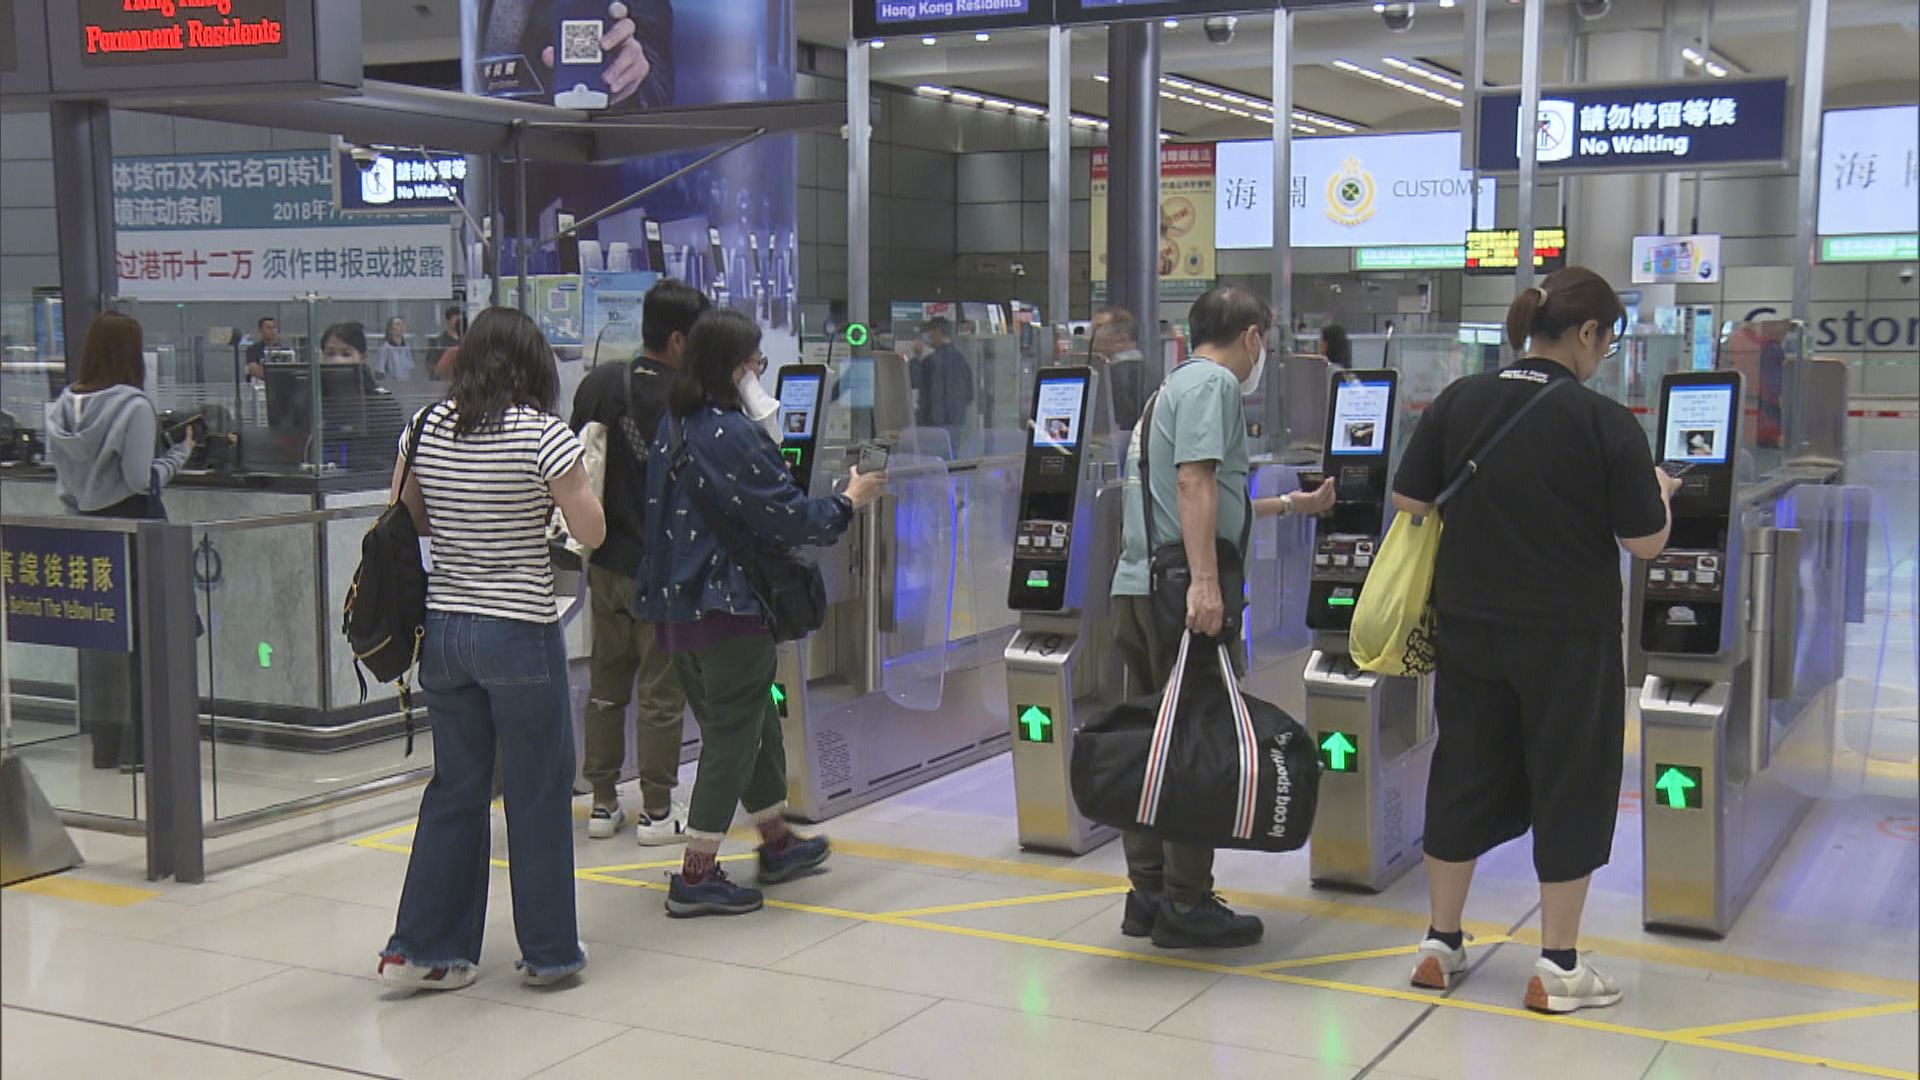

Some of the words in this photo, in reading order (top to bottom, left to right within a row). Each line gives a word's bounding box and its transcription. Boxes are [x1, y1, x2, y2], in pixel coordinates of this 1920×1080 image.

[881, 4, 917, 18] Hong
[918, 0, 953, 15] Kong
[85, 24, 184, 53] Permanent
[187, 18, 281, 47] Residents
[1579, 97, 1737, 132] 請勿停留等候
[1579, 137, 1609, 155] No
[1612, 133, 1689, 155] Waiting
[117, 249, 253, 281] 过港币十二万
[263, 246, 444, 280] 须作申报或披露
[94, 601, 115, 623] Line
[1661, 680, 1713, 707] 17
[1273, 795, 1292, 824] coq
[1266, 823, 1286, 838] le
